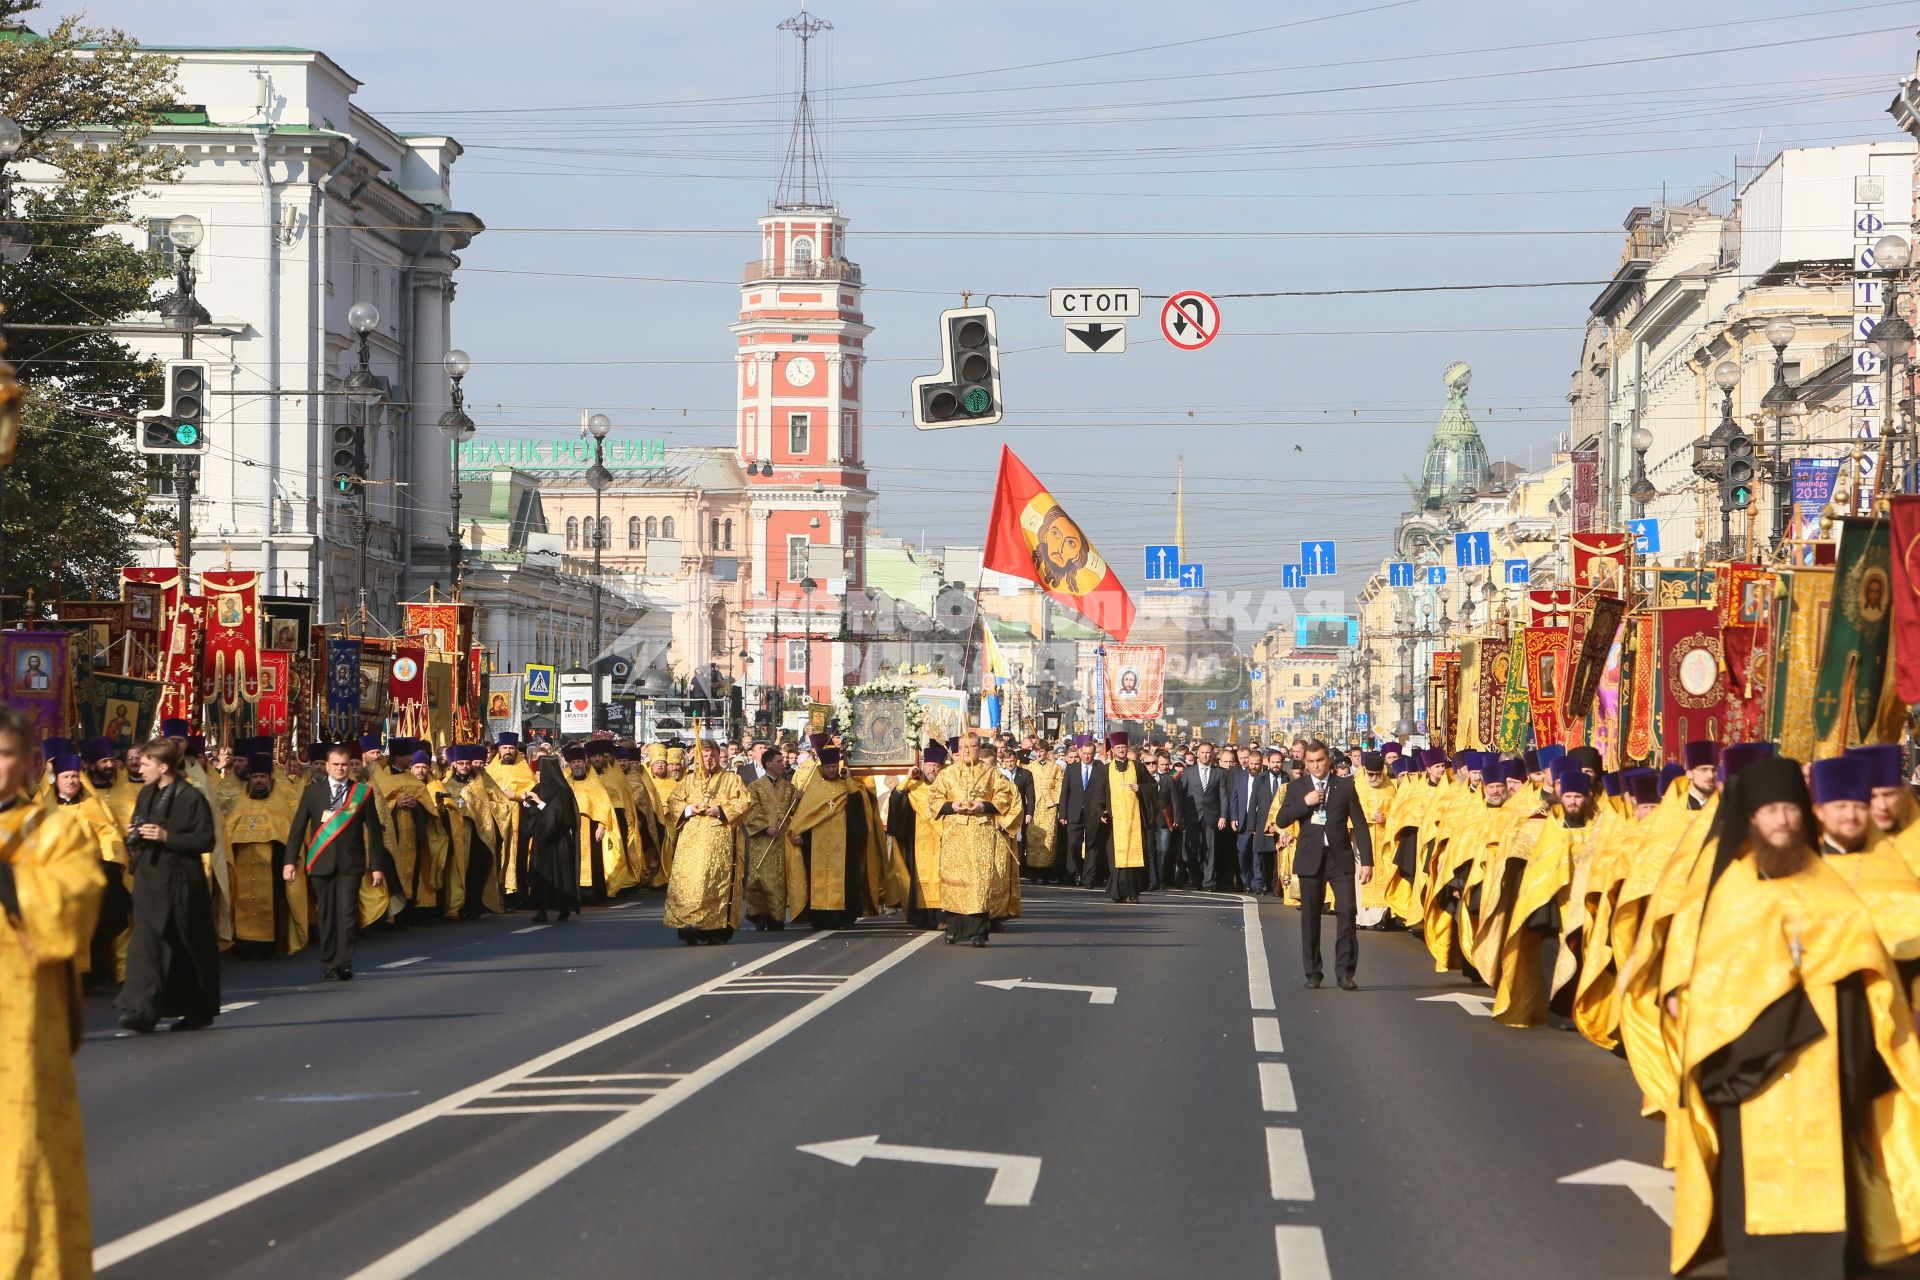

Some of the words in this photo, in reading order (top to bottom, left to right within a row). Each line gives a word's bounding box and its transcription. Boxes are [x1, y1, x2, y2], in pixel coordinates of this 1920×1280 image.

[1062, 294, 1128, 312] СТОП
[1857, 213, 1883, 509] ФОТОСАЛОН
[1815, 471, 1828, 480] 22
[1796, 480, 1828, 488] сентября
[1796, 487, 1828, 498] 2013
